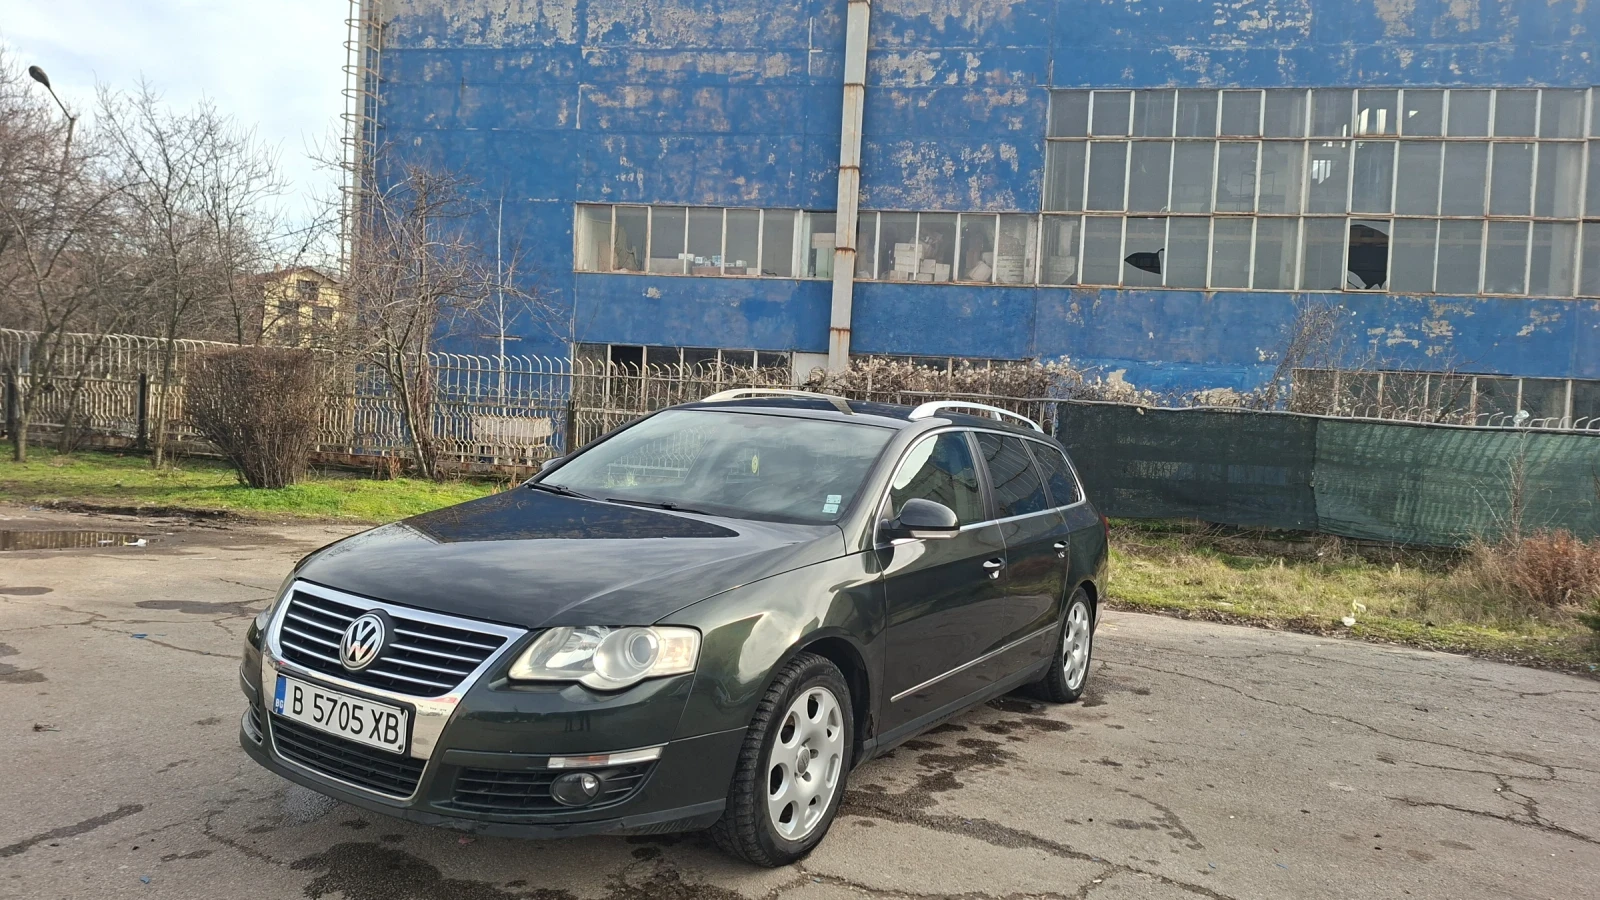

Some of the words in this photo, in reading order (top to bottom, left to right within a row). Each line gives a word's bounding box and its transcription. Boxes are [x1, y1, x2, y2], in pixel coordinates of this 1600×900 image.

[342, 616, 382, 667] VW
[275, 698, 285, 709] BG
[293, 686, 304, 715] B
[313, 694, 364, 734] 5705
[368, 709, 399, 744] XB
